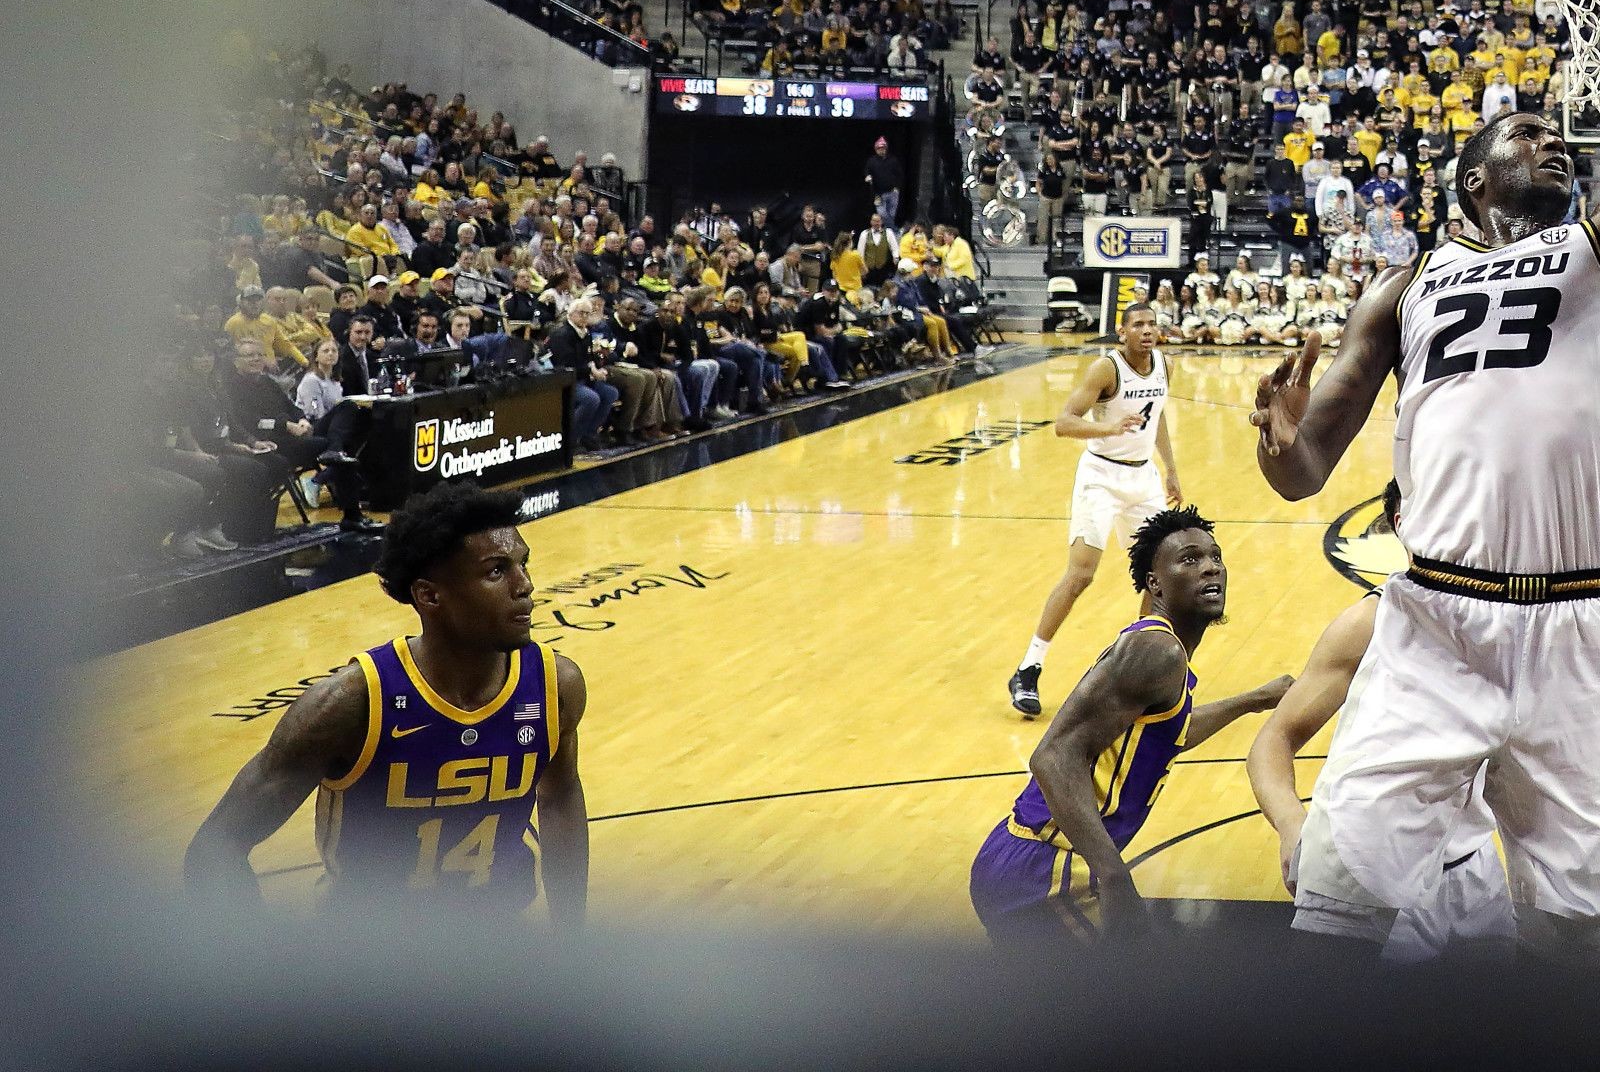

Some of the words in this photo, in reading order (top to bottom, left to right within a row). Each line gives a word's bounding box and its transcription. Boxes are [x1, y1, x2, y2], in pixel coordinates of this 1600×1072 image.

[742, 95, 767, 115] 38
[831, 97, 854, 118] 39
[1100, 227, 1128, 257] SEC
[1129, 244, 1163, 255] NETWORK
[1540, 227, 1569, 244] SEC
[1420, 251, 1571, 299] MIZZOU
[1422, 286, 1562, 385] 23
[1124, 387, 1165, 400] MIZZOU
[442, 410, 495, 446] Missouri
[1138, 401, 1154, 431] 4
[417, 424, 436, 466] MU
[440, 437, 515, 479] Orthopaedic
[514, 431, 563, 460] Institute
[518, 726, 535, 745] SEC
[386, 752, 538, 808] LSU
[407, 813, 501, 889] 14
